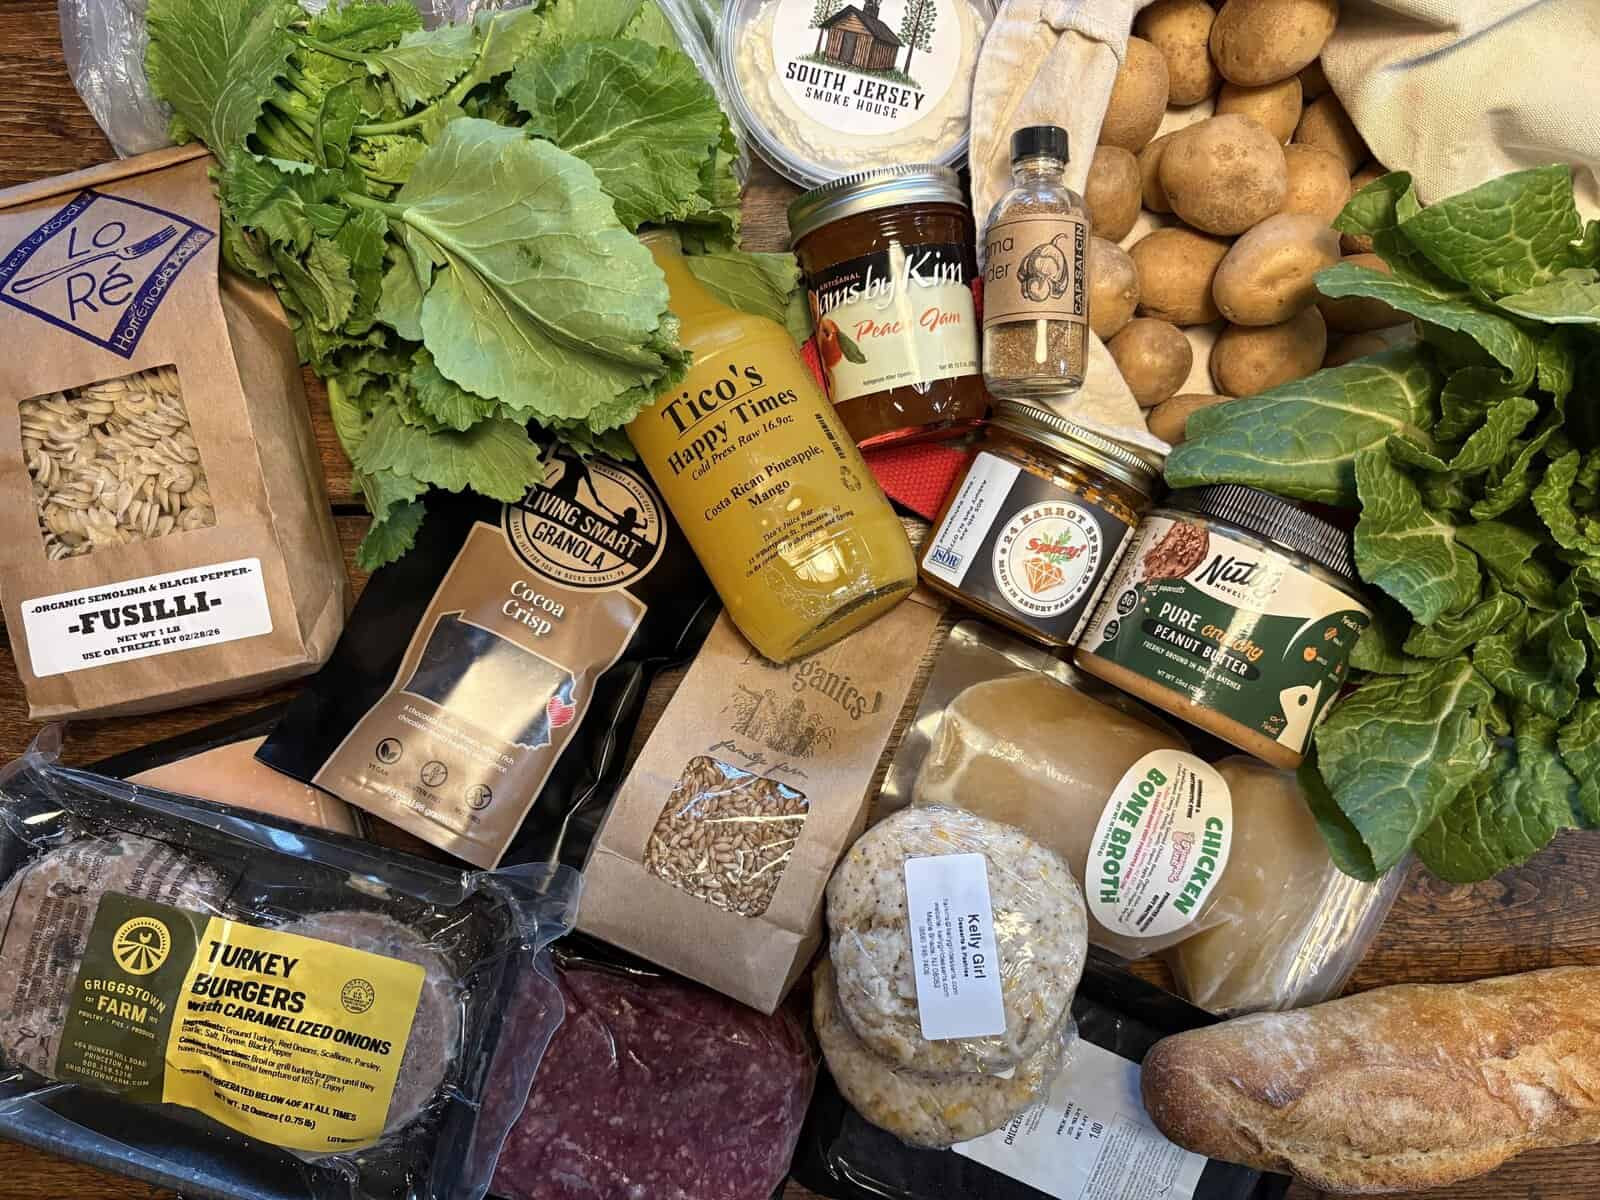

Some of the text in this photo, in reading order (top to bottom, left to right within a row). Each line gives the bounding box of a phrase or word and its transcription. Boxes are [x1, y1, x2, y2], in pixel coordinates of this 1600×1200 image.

[785, 61, 926, 111] SOUTH JERSEY
[805, 86, 899, 119] SMOKE HOUSE
[68, 222, 126, 259] LO
[67, 263, 133, 321] Ré
[864, 264, 896, 312] by
[903, 250, 963, 290] Kim
[853, 307, 961, 343] Peac Jam
[660, 364, 764, 435] Tico's
[667, 388, 798, 477] Happy Times
[692, 460, 712, 481] Cold
[711, 443, 737, 467] Press
[738, 430, 760, 449] Raw
[704, 443, 825, 521] Costa Rican Pineapple,
[747, 479, 790, 509] Mango
[523, 485, 643, 559] LIVING SMART
[1003, 528, 1019, 545] 24
[1021, 506, 1087, 525] KARROT
[532, 521, 606, 570] GRANOLA
[1026, 537, 1087, 560] Spicy!
[88, 585, 147, 604] SEMOLINA
[148, 584, 158, 593] &
[159, 576, 199, 591] BLACK
[200, 566, 253, 583] PEPPER-
[510, 579, 566, 619] Cocoa
[998, 560, 1076, 612] MADE IN ASBURY PARK
[68, 591, 223, 635] -FUSILLI-
[502, 600, 552, 637] Crisp
[1159, 602, 1202, 632] PURE
[82, 627, 221, 661] USE OR FREEZE BY 02/28/26
[117, 625, 181, 644] NET WT 1 LB
[1153, 624, 1200, 653] PEANUT
[1202, 645, 1249, 676] BUTTER
[1119, 768, 1168, 829] BONE
[1099, 826, 1132, 904] BROTH
[1173, 816, 1223, 916] CHICKEN
[207, 940, 299, 979] TURKEY
[967, 914, 987, 979] Kelly Girl
[84, 979, 167, 1014] GRIGGSTOWN
[97, 995, 148, 1024] FARM
[191, 973, 307, 1014] BURGERS
[78, 1010, 104, 1023] POULTRY
[186, 999, 392, 1057] with CARAMELIZED ONIONS
[183, 1018, 226, 1033] Ingredients:
[225, 1026, 252, 1041] Ground
[253, 1031, 277, 1047] Turkey,
[278, 1037, 293, 1048] Red
[320, 1048, 354, 1065] Scallions,
[354, 1058, 382, 1073] Parsley,
[204, 1028, 220, 1042] Salt,
[220, 1032, 246, 1048] Thyme,
[248, 1039, 270, 1052] Black
[270, 1044, 293, 1059] Pepper
[250, 1055, 268, 1066] Broil
[267, 1060, 276, 1068] or
[276, 1061, 291, 1073] grill
[291, 1064, 314, 1078] turkey
[314, 1069, 341, 1084] burgers
[342, 1076, 360, 1088] until
[359, 1080, 376, 1093] they
[292, 1073, 301, 1082] of
[322, 1081, 346, 1094] Enjoy!
[241, 1103, 250, 1113] 12
[250, 1105, 279, 1121] Ounces
[255, 1092, 285, 1105] BELOW
[303, 1100, 315, 1112] AT
[315, 1103, 331, 1116] ALL
[332, 1108, 357, 1122] TIMES
